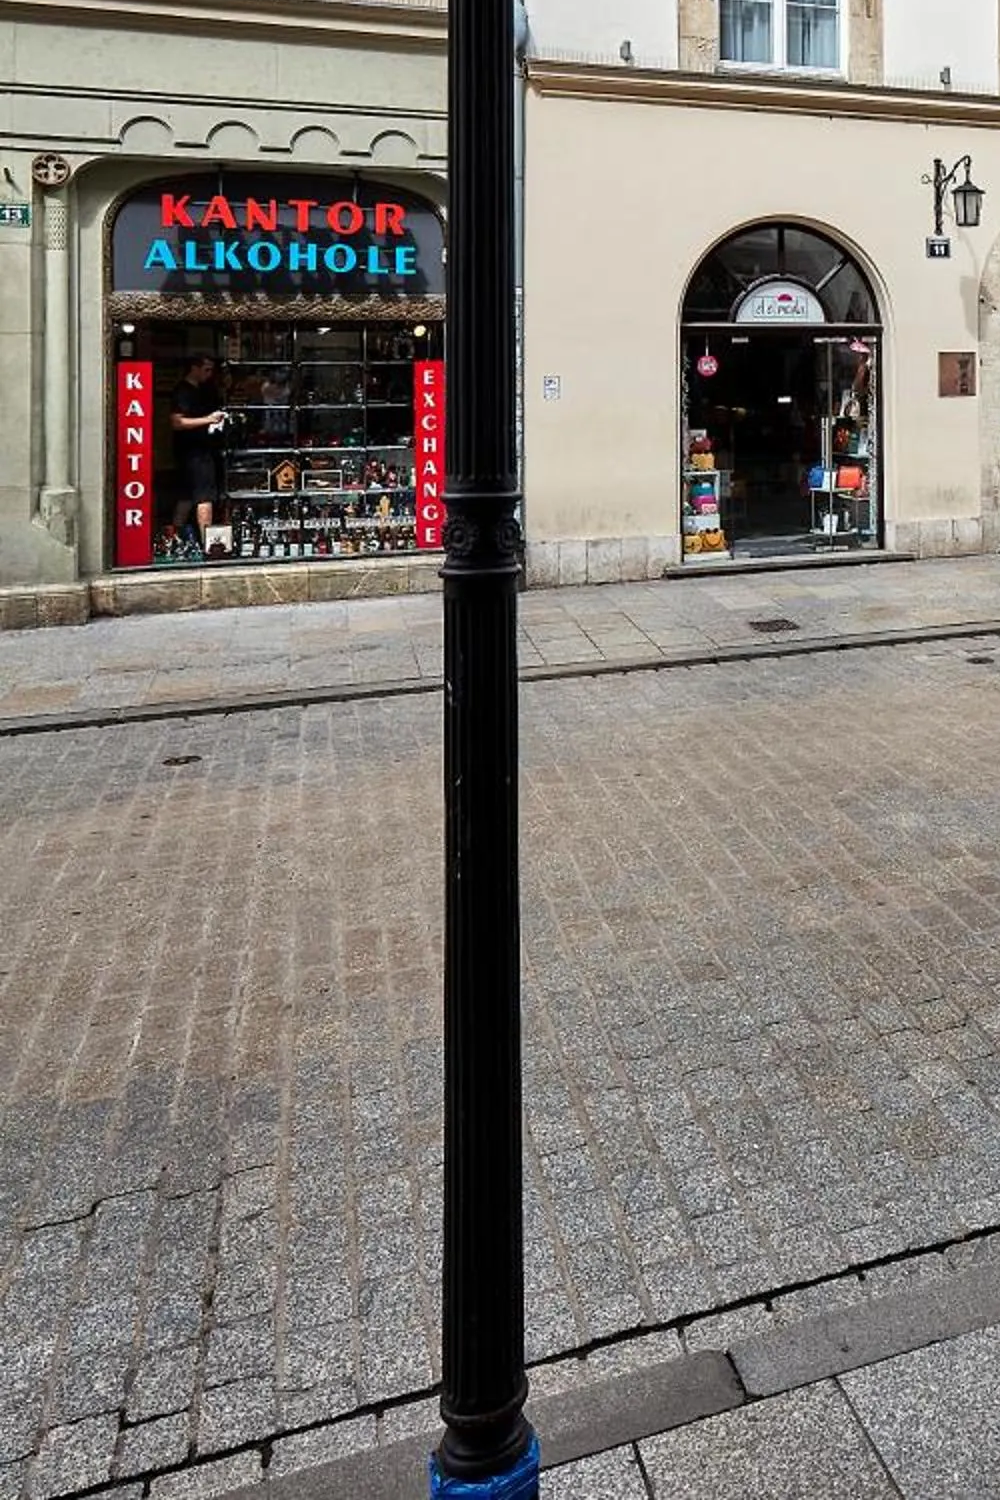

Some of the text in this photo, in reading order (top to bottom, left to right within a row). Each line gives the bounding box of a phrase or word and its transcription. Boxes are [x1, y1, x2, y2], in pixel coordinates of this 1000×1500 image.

[160, 194, 405, 234] KANTOR
[144, 239, 416, 275] ALKOHOLE
[934, 244, 945, 255] 11
[124, 372, 145, 527] KANTOR
[421, 369, 438, 543] EXCHANGE
